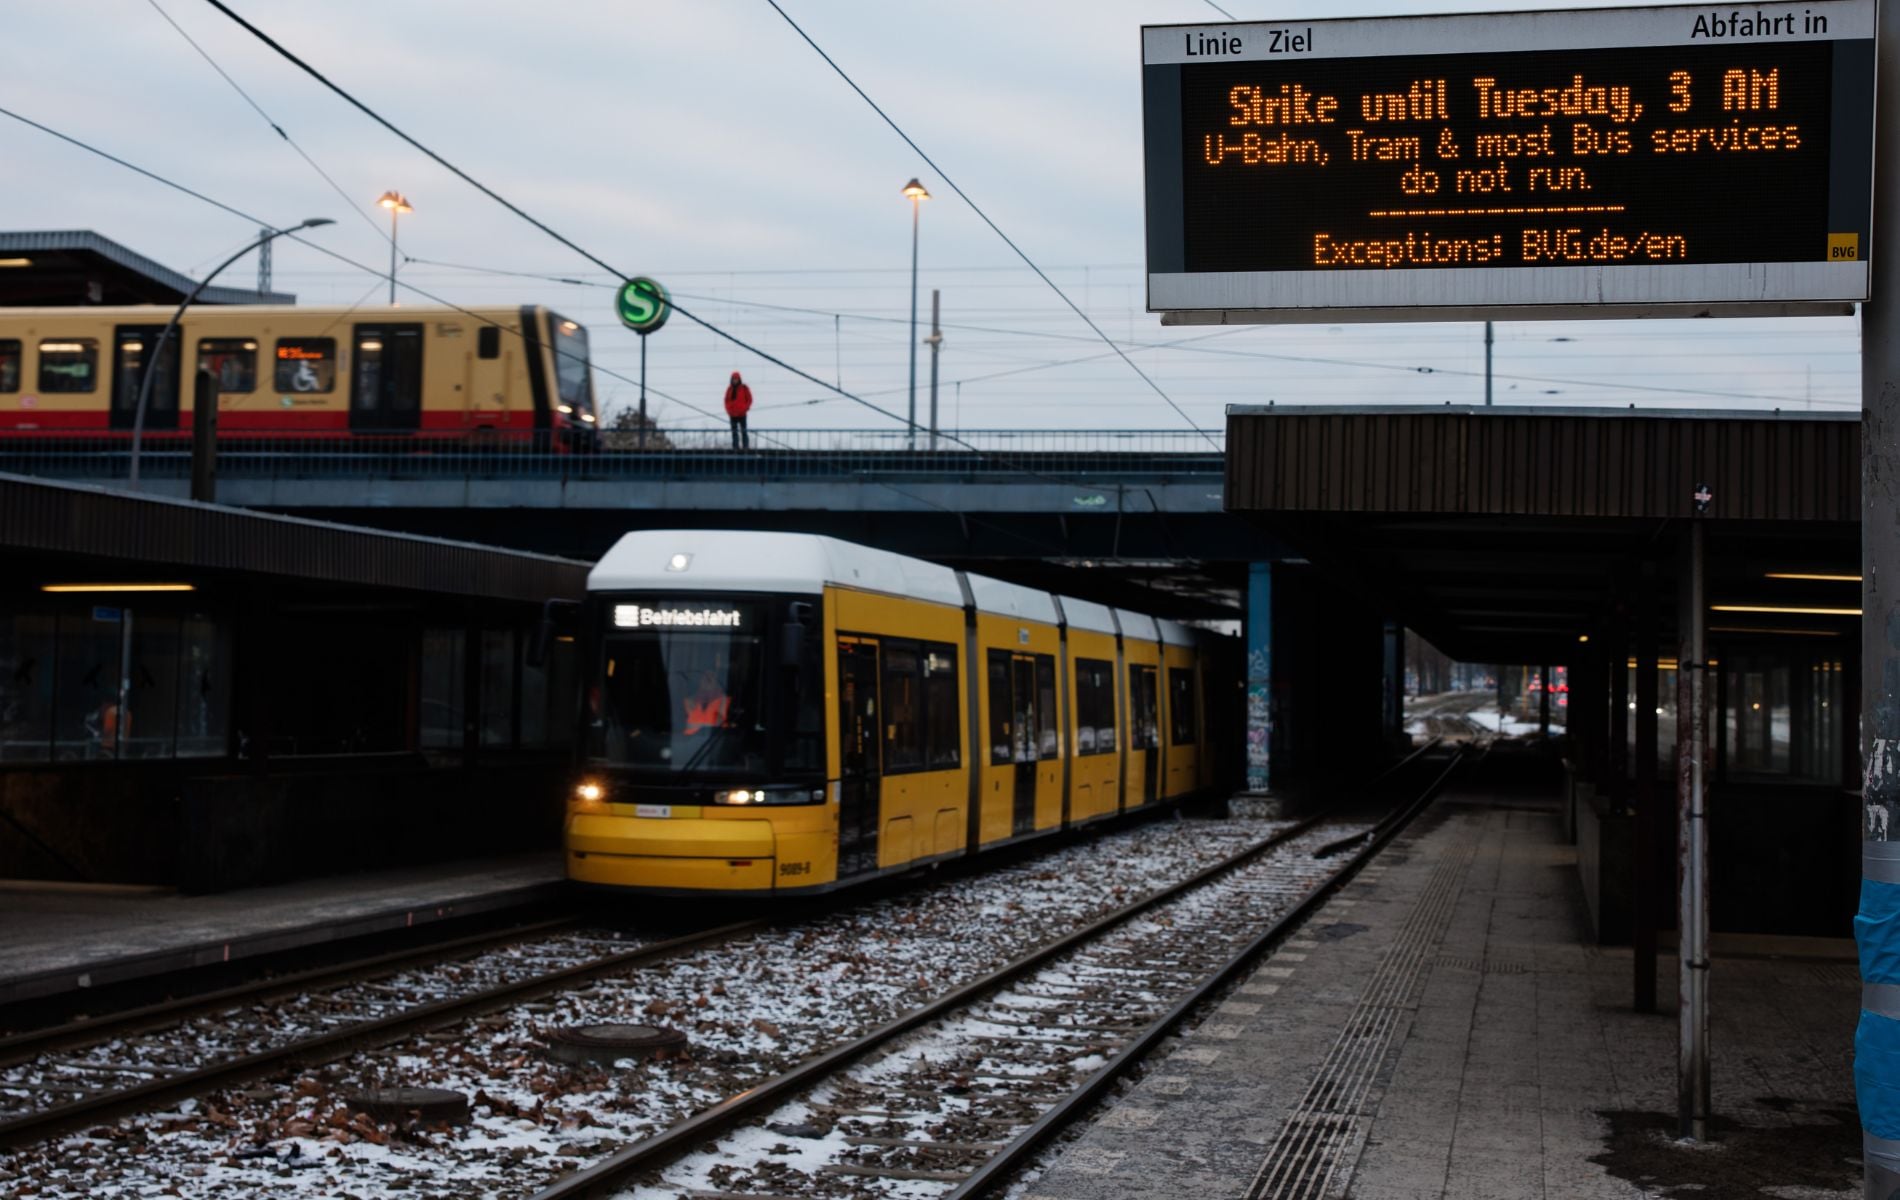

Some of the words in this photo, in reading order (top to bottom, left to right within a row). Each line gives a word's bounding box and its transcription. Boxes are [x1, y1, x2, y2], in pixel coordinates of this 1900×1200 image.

[1691, 13, 1795, 39] Abfahrt
[1804, 10, 1828, 34] in
[1185, 31, 1243, 56] Linie
[1268, 28, 1313, 53] Ziel
[1230, 84, 1338, 125] Strike
[1361, 80, 1449, 120] until
[1473, 75, 1643, 122] Tuesday,
[1669, 71, 1691, 112] 3
[1723, 68, 1779, 110] AM
[1204, 132, 1329, 166] U-Bahn,
[1346, 130, 1420, 160] Tram
[1437, 127, 1459, 158] &
[1476, 124, 1555, 157] most
[1572, 123, 1633, 154] Bus
[1651, 118, 1801, 152] services
[1401, 163, 1440, 194] do
[1455, 160, 1512, 192] not
[1529, 167, 1592, 191] run.
[1314, 232, 1503, 267] Exceptions:
[1522, 228, 1687, 260] BVG.de/en
[1832, 246, 1855, 258] BVG
[625, 284, 655, 322] S
[640, 608, 741, 626] Betriebsfahrt
